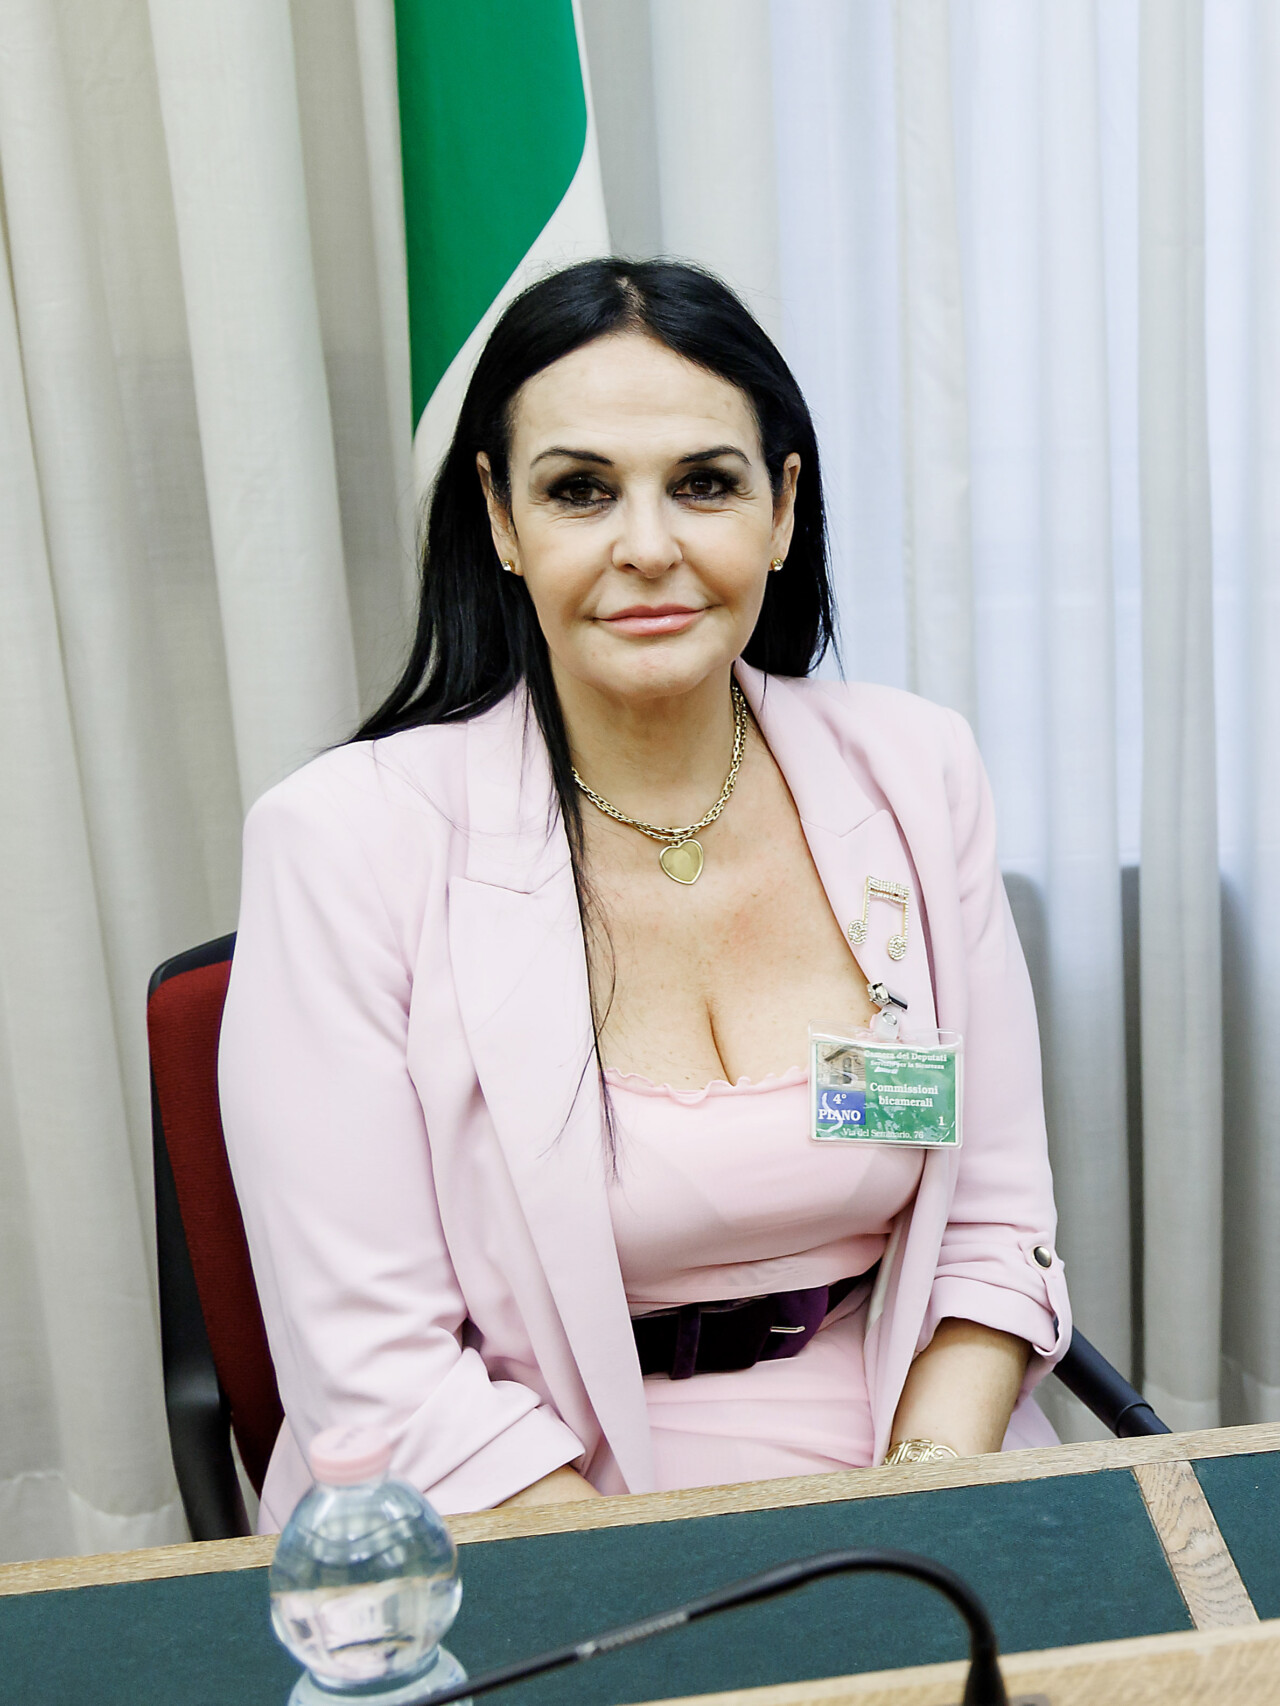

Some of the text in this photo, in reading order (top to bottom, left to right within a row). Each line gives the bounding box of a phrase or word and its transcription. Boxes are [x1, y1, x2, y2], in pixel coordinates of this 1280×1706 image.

[911, 1053, 948, 1063] Deputati
[870, 1082, 939, 1095] Commissioni
[878, 1096, 933, 1107] bicamerali
